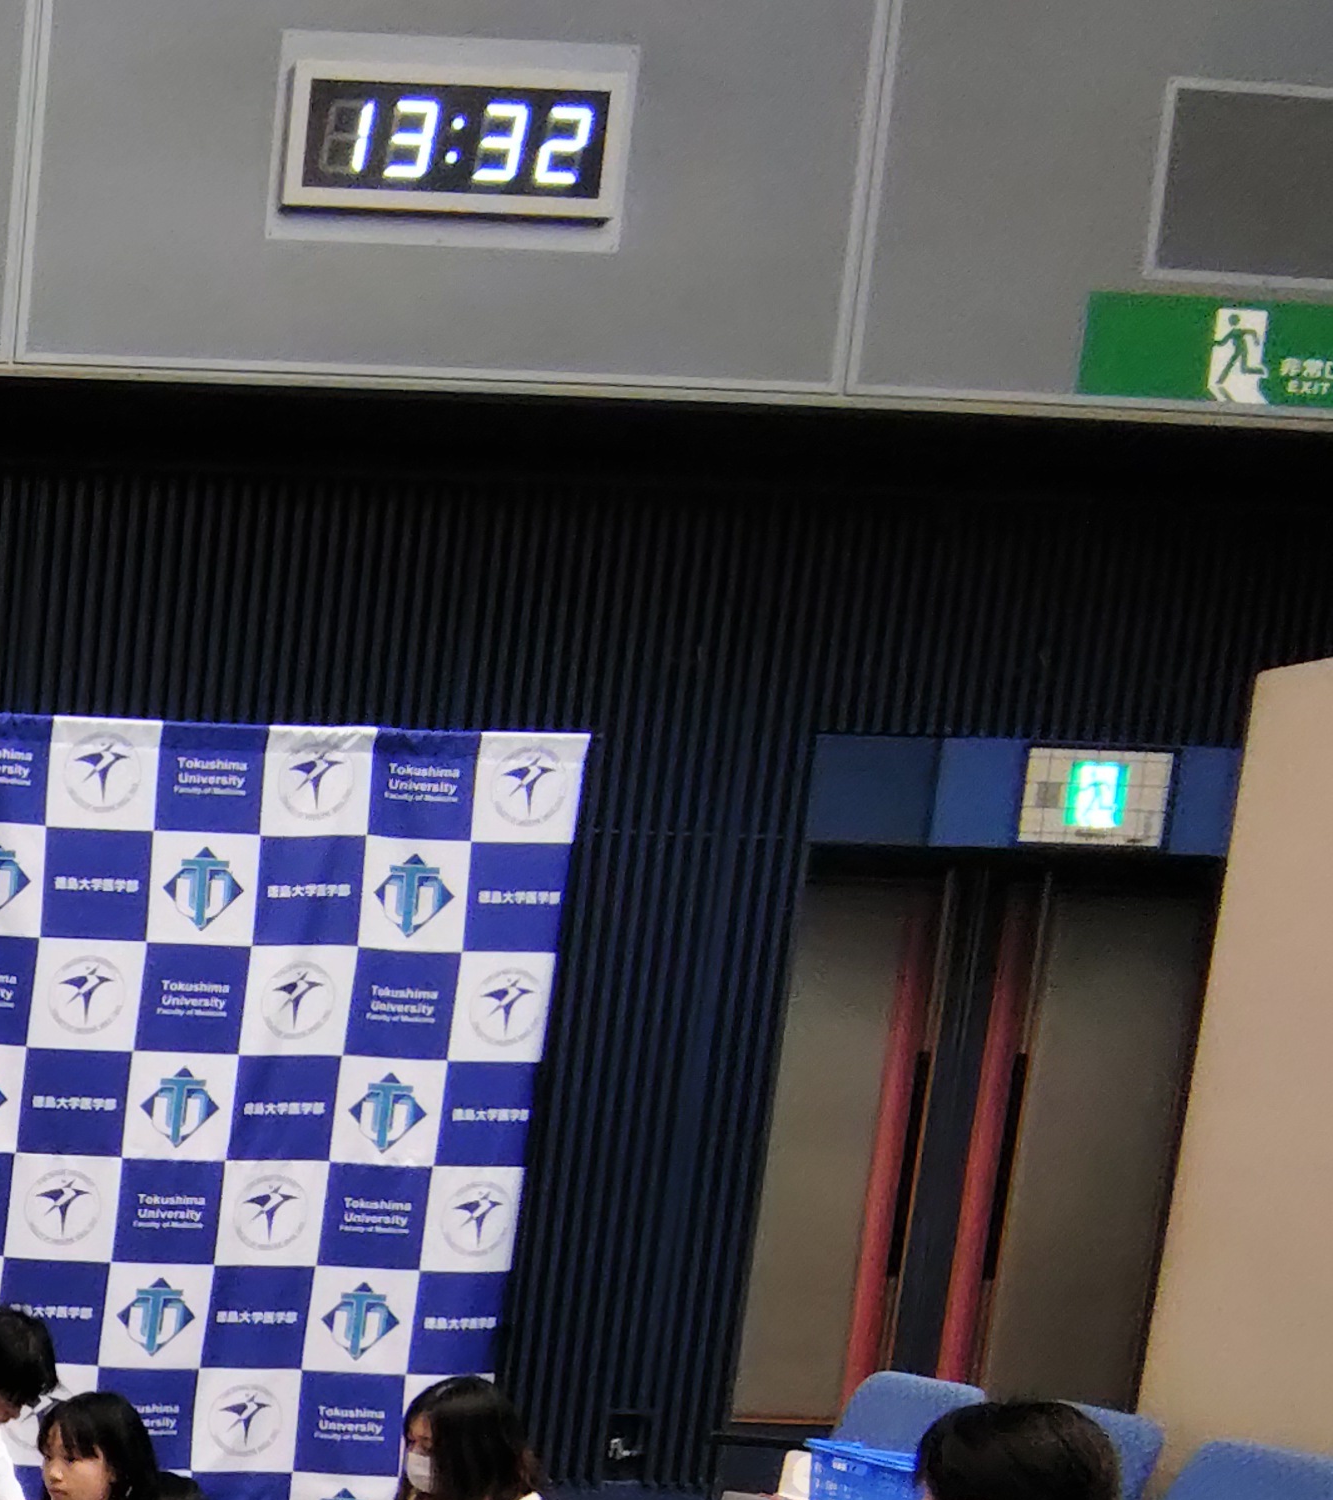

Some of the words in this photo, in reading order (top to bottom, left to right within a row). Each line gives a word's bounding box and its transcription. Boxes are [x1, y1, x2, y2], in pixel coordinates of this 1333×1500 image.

[351, 98, 594, 185] 13:32
[1288, 381, 1330, 395] EXIT
[178, 757, 247, 771] Tokushima
[390, 763, 460, 778] Tokushima
[178, 773, 245, 787] University
[389, 778, 457, 795] University
[162, 980, 230, 993] Tokushima
[372, 985, 438, 999] Tokushima
[162, 995, 225, 1009] University
[371, 1000, 434, 1016] University
[138, 1194, 205, 1205] Tokushima
[344, 1197, 412, 1211] Tokushima
[138, 1209, 202, 1222] University
[344, 1212, 408, 1226] University
[134, 1403, 179, 1414] ushima
[318, 1406, 385, 1419] Tokushima
[142, 1417, 176, 1429] ersity
[319, 1420, 383, 1434] University
